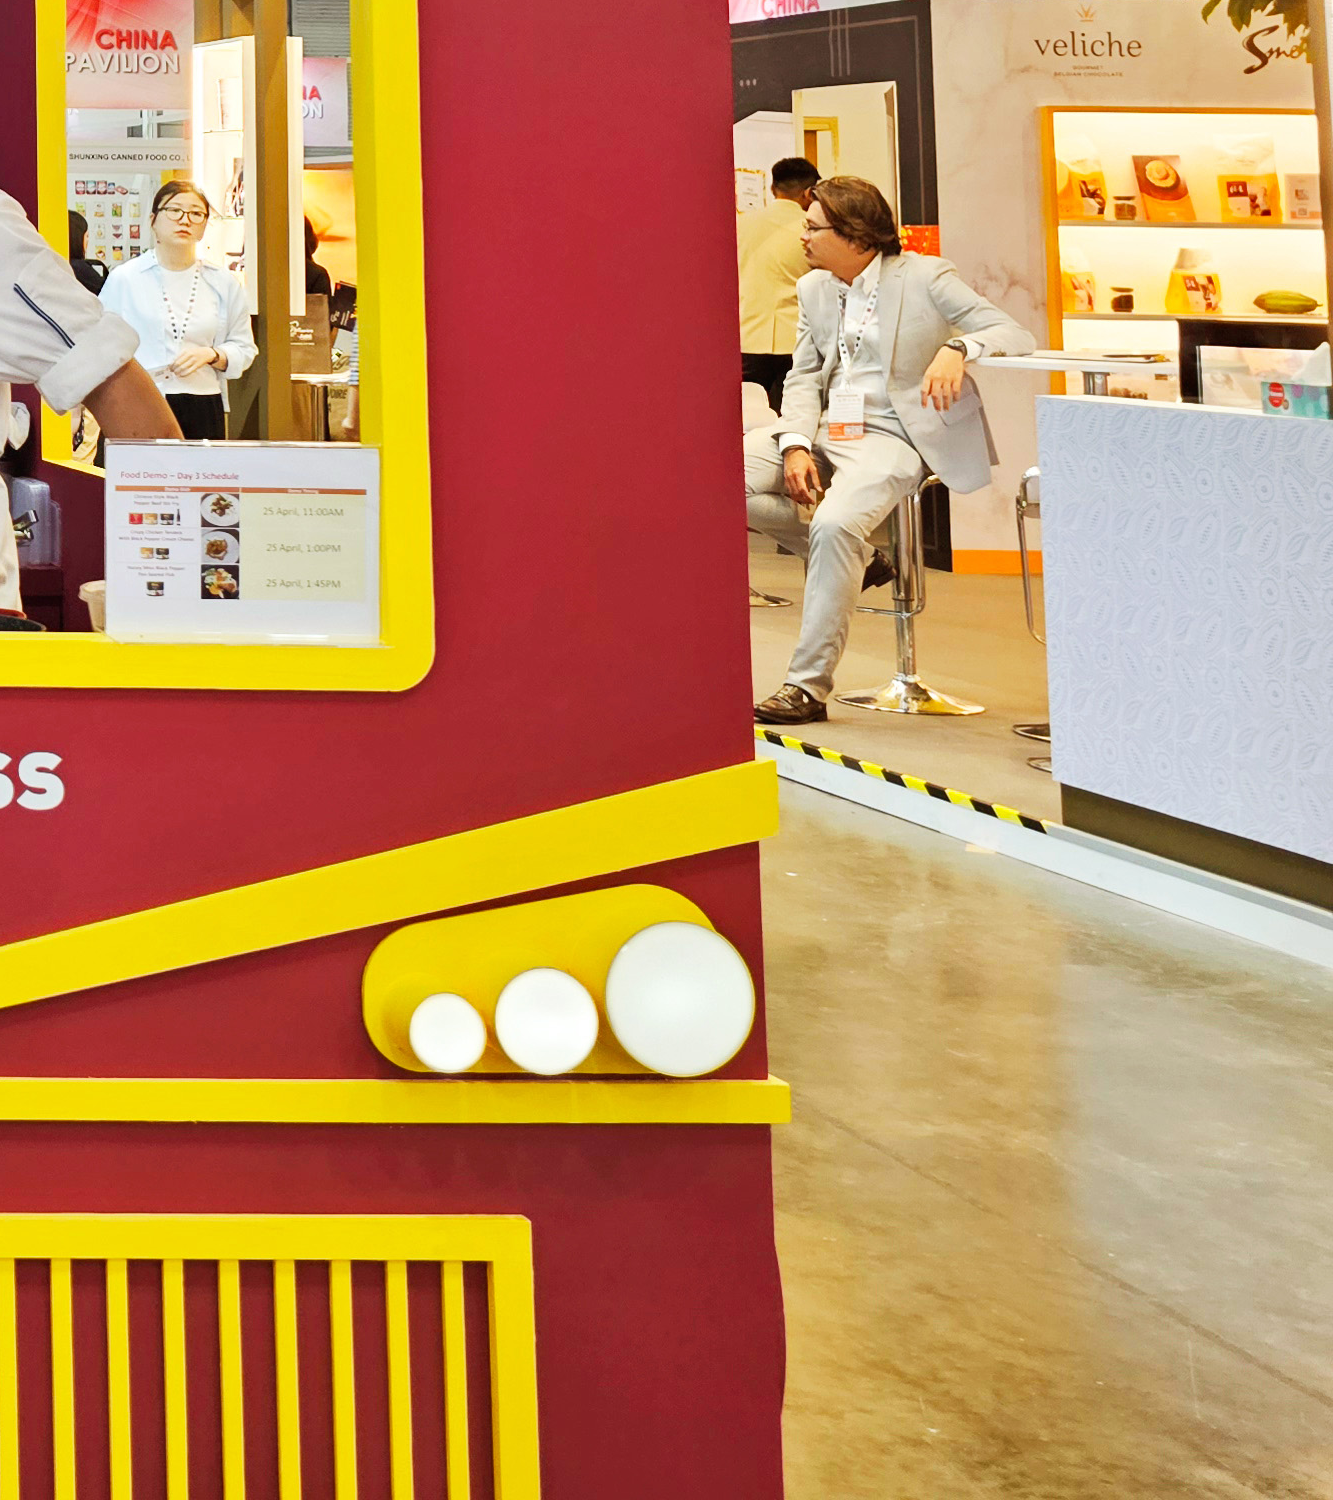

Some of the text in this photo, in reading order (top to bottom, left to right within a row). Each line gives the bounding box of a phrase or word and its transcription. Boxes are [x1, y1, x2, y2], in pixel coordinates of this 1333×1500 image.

[95, 28, 178, 51] CHINA
[1034, 31, 1142, 57] veliche
[65, 51, 180, 74] PAVILION
[68, 153, 109, 161] SHUNXING
[110, 153, 144, 161] CANNED
[120, 471, 140, 479] Food
[143, 471, 168, 479] Demo
[177, 472, 193, 480] Day
[202, 472, 239, 480] Schedule
[263, 507, 344, 517] 25 April, 11:00AM
[266, 543, 342, 553] 25 April, 1:00PM
[266, 579, 342, 589] 25 April, 1:45PM
